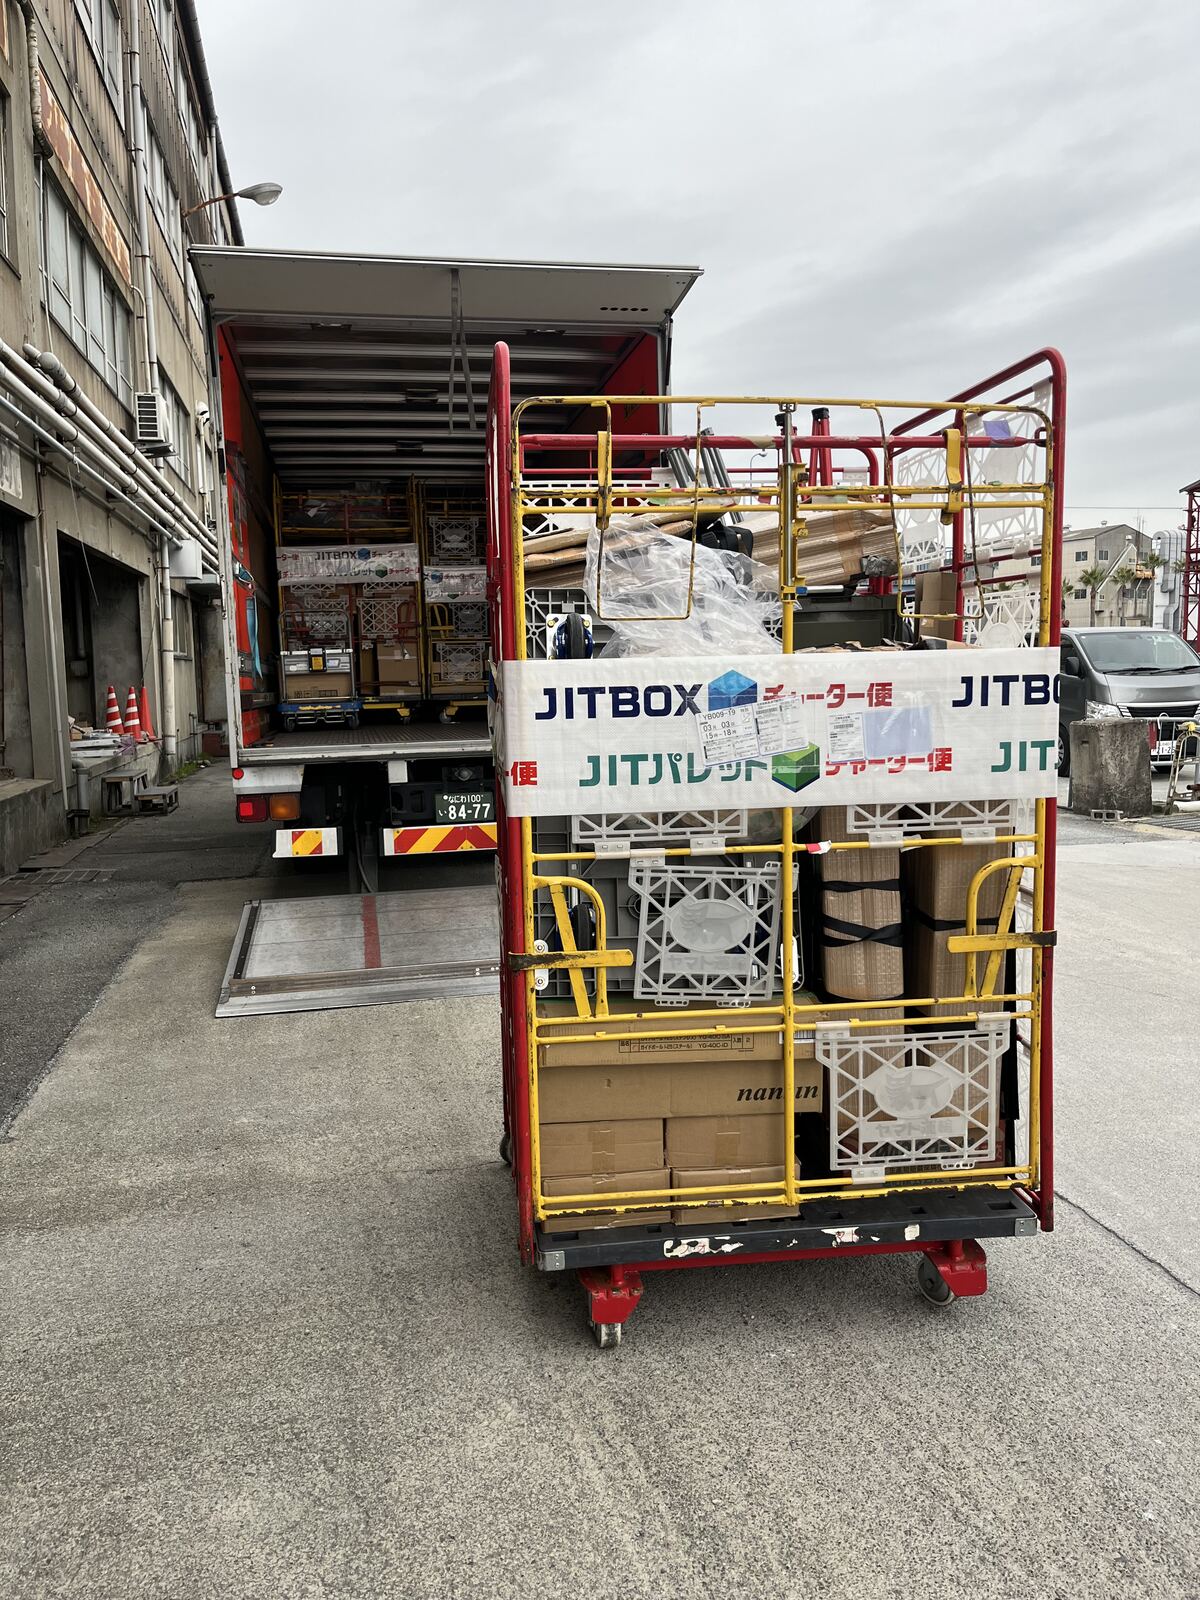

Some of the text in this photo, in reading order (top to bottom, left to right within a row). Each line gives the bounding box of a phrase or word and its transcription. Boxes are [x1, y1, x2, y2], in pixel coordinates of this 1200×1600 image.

[535, 683, 703, 720] JITBOX
[763, 682, 892, 708] チーター便
[448, 803, 491, 820] 84-77
[736, 1085, 819, 1101] nanin
